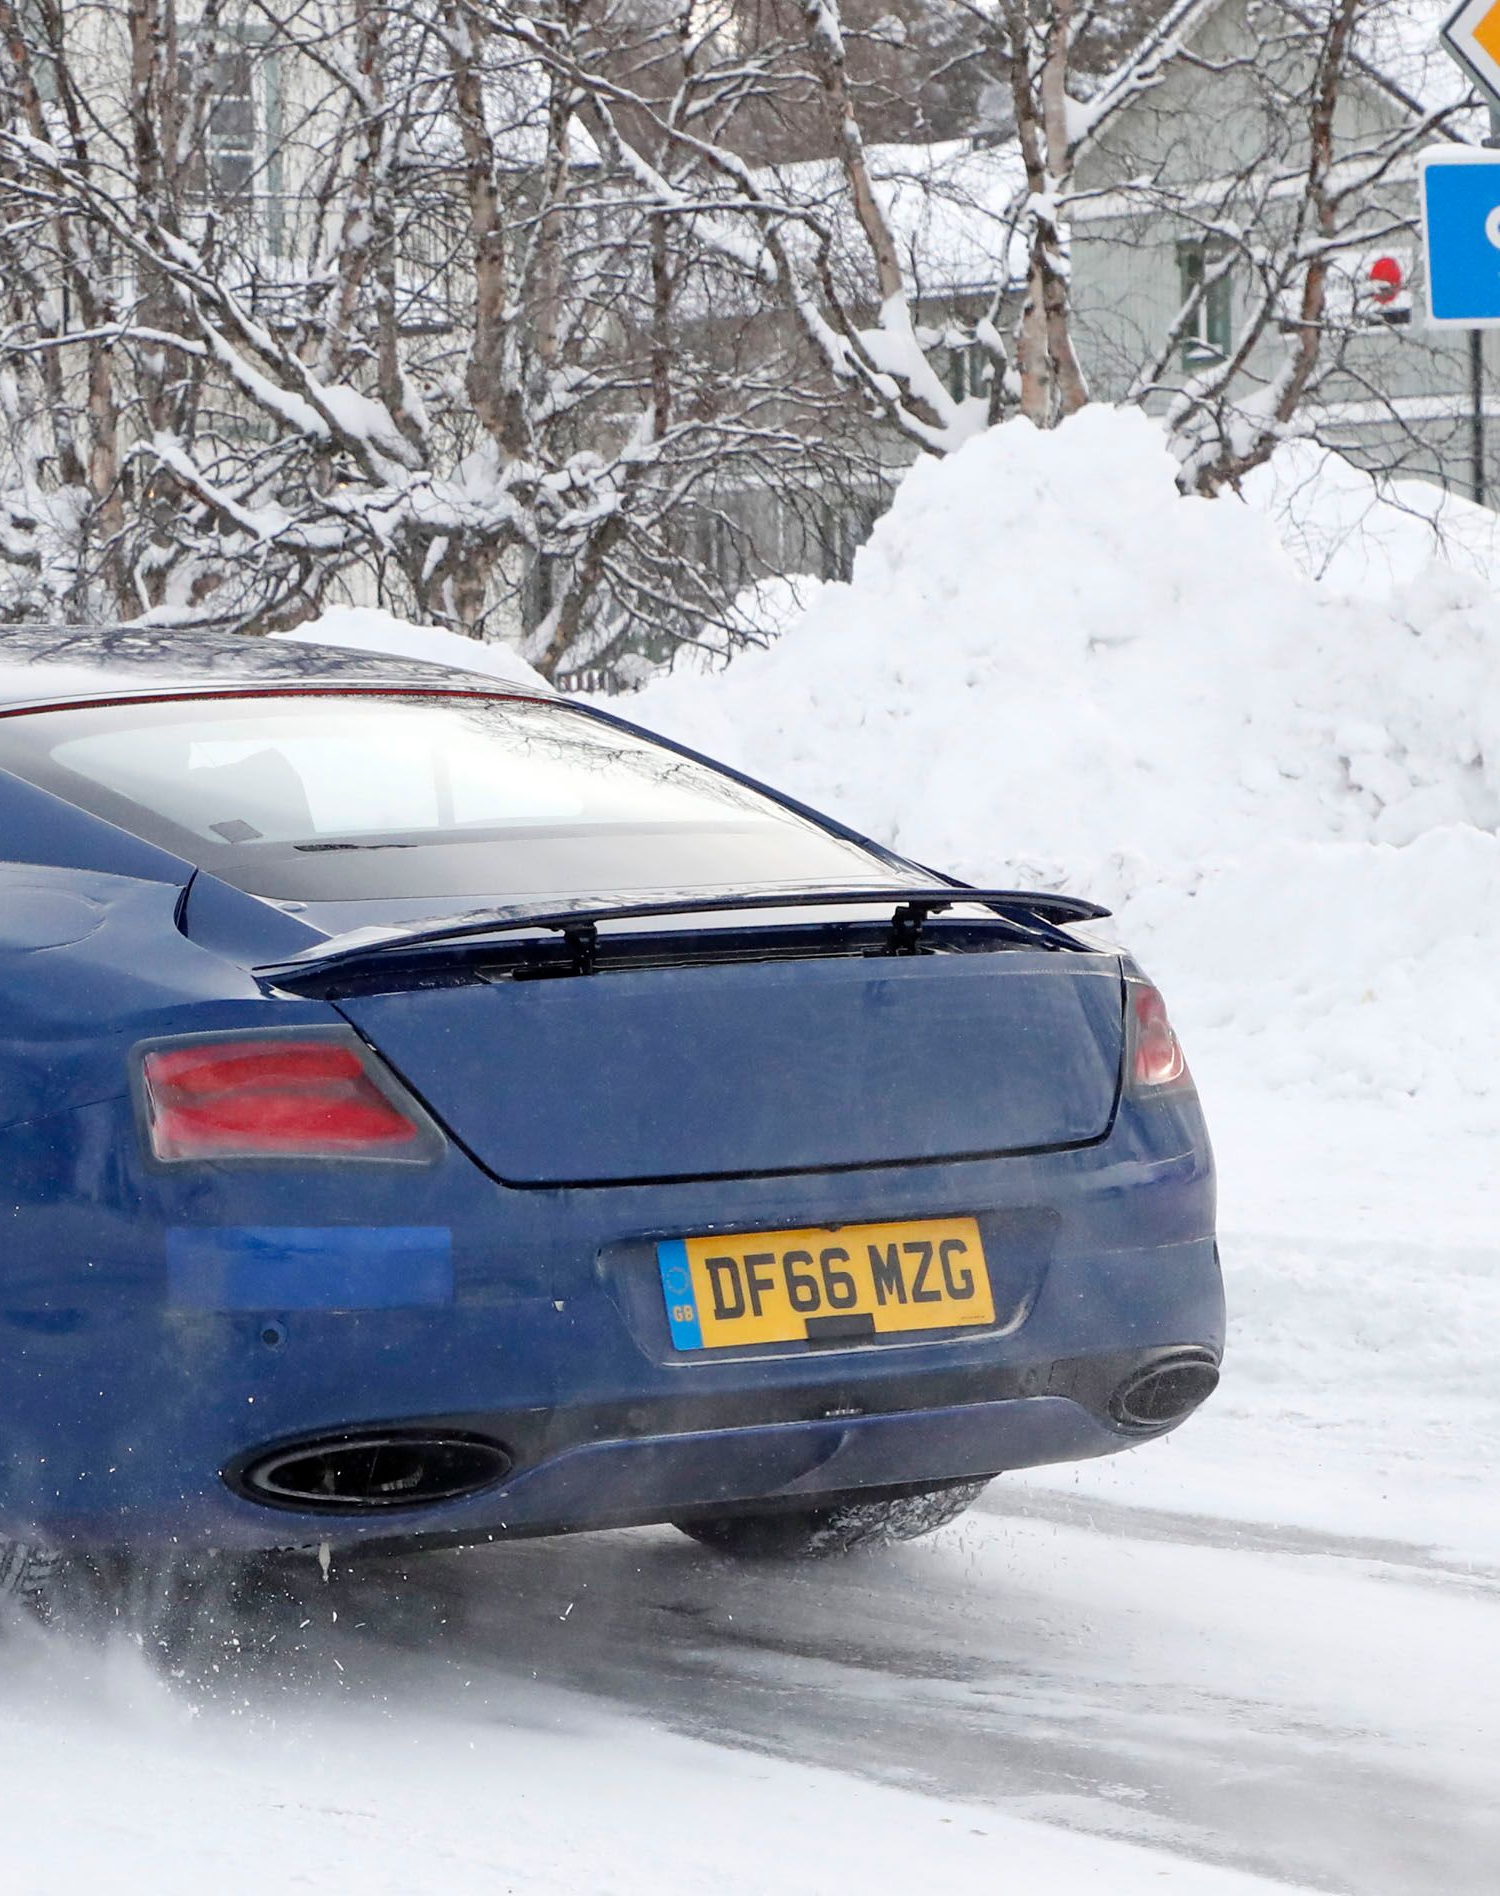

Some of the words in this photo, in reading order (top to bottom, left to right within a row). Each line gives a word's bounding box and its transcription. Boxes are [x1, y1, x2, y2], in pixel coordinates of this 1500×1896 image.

[705, 1247, 858, 1320] DF66
[868, 1239, 975, 1306] MZG
[673, 1304, 694, 1322] GB
